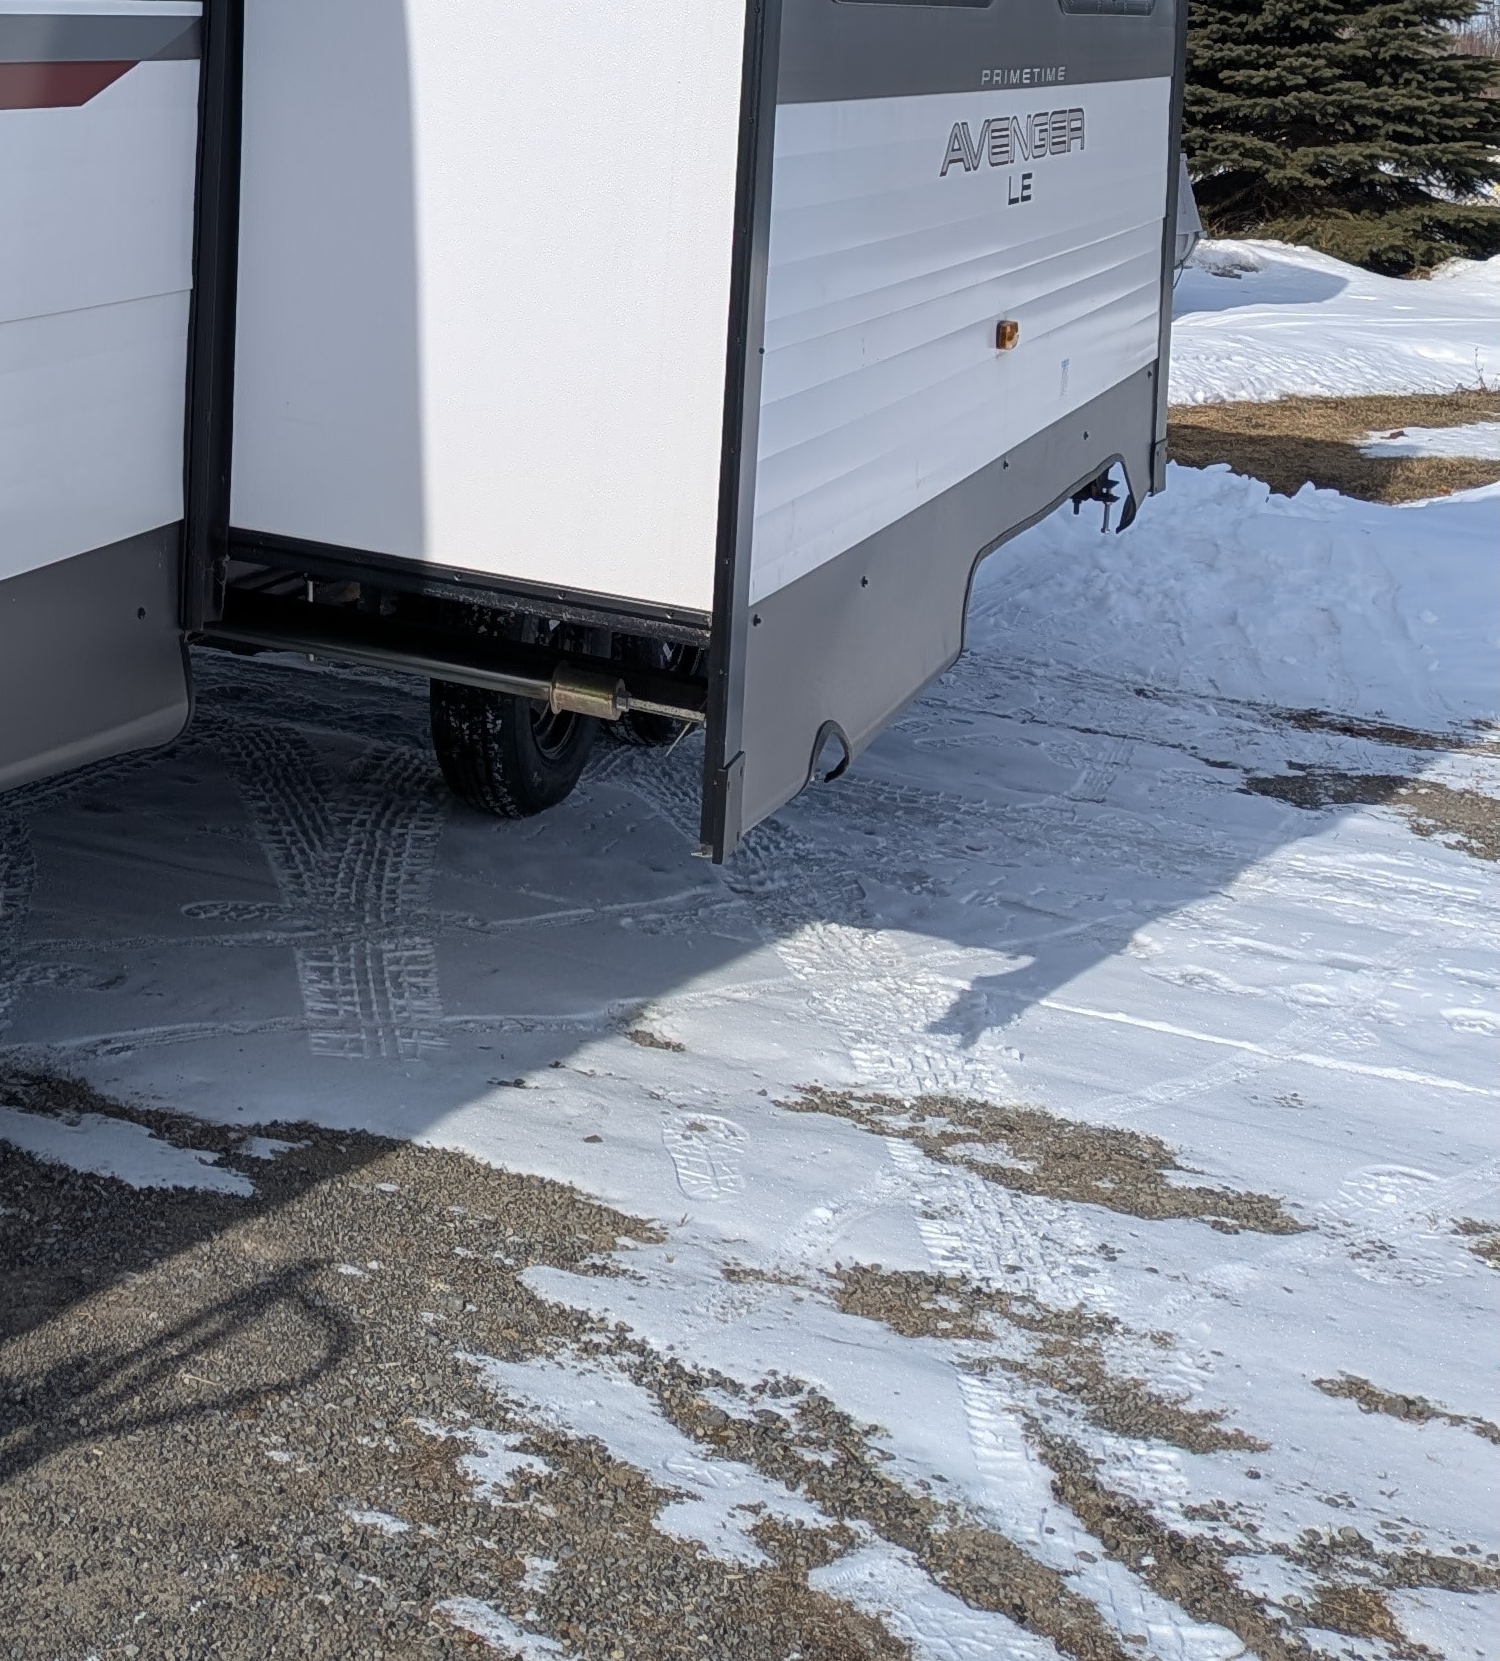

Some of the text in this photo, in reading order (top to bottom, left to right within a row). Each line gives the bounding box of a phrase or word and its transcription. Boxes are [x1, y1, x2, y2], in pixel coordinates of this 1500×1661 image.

[981, 66, 1066, 85] PRIMETIME
[939, 107, 1085, 177] AVENGER
[1008, 172, 1033, 205] LE
